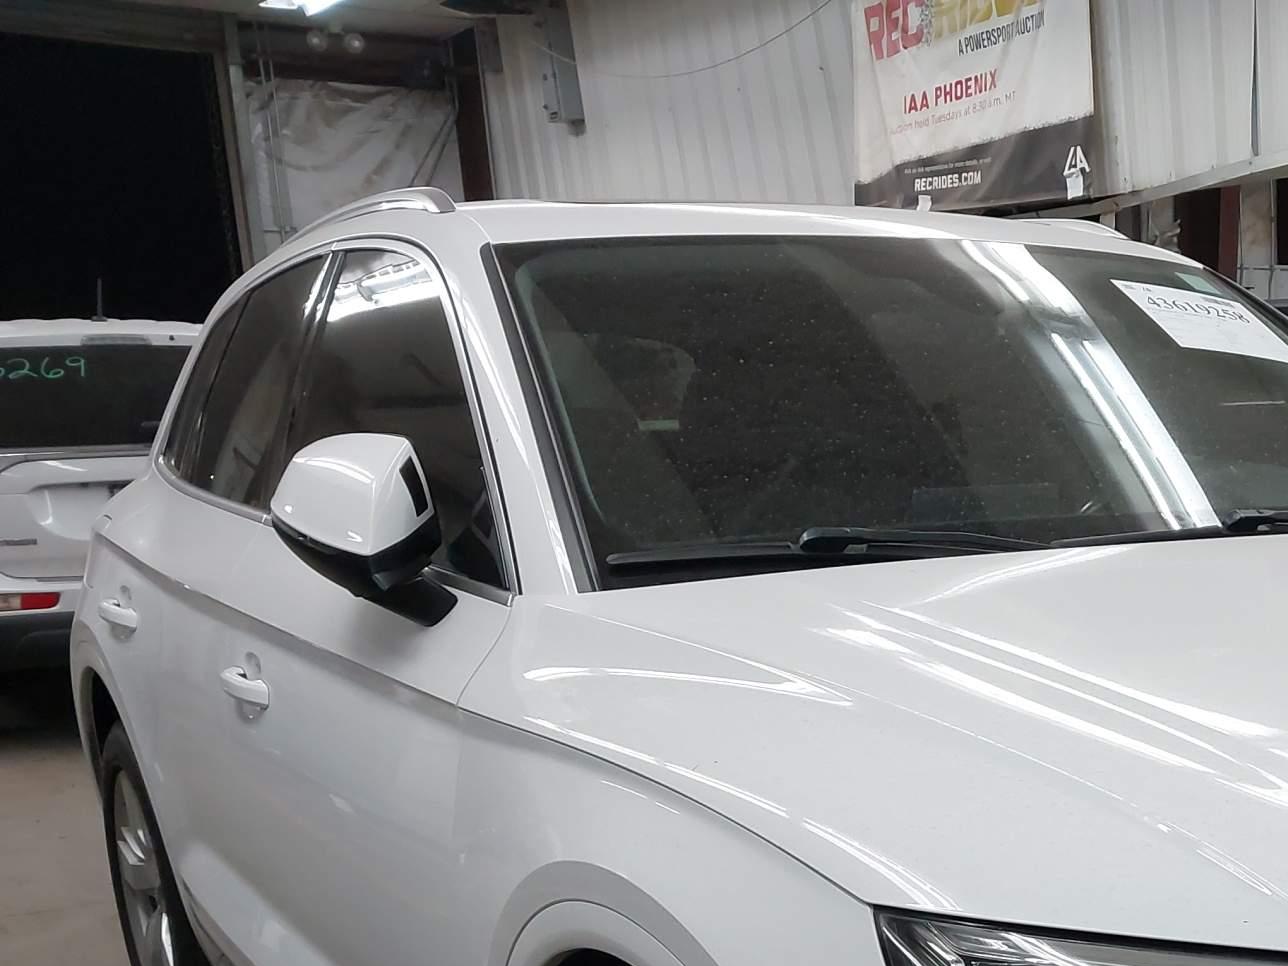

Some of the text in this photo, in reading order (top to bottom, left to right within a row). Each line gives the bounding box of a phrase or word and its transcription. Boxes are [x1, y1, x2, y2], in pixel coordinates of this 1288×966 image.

[958, 38, 965, 56] A
[964, 22, 1015, 54] POWERSPORT
[1014, 8, 1045, 37] AUCTION
[903, 68, 998, 115] IAA PHOENIX
[914, 170, 982, 192] RECRIDES.COM
[1147, 296, 1250, 324] 43619258
